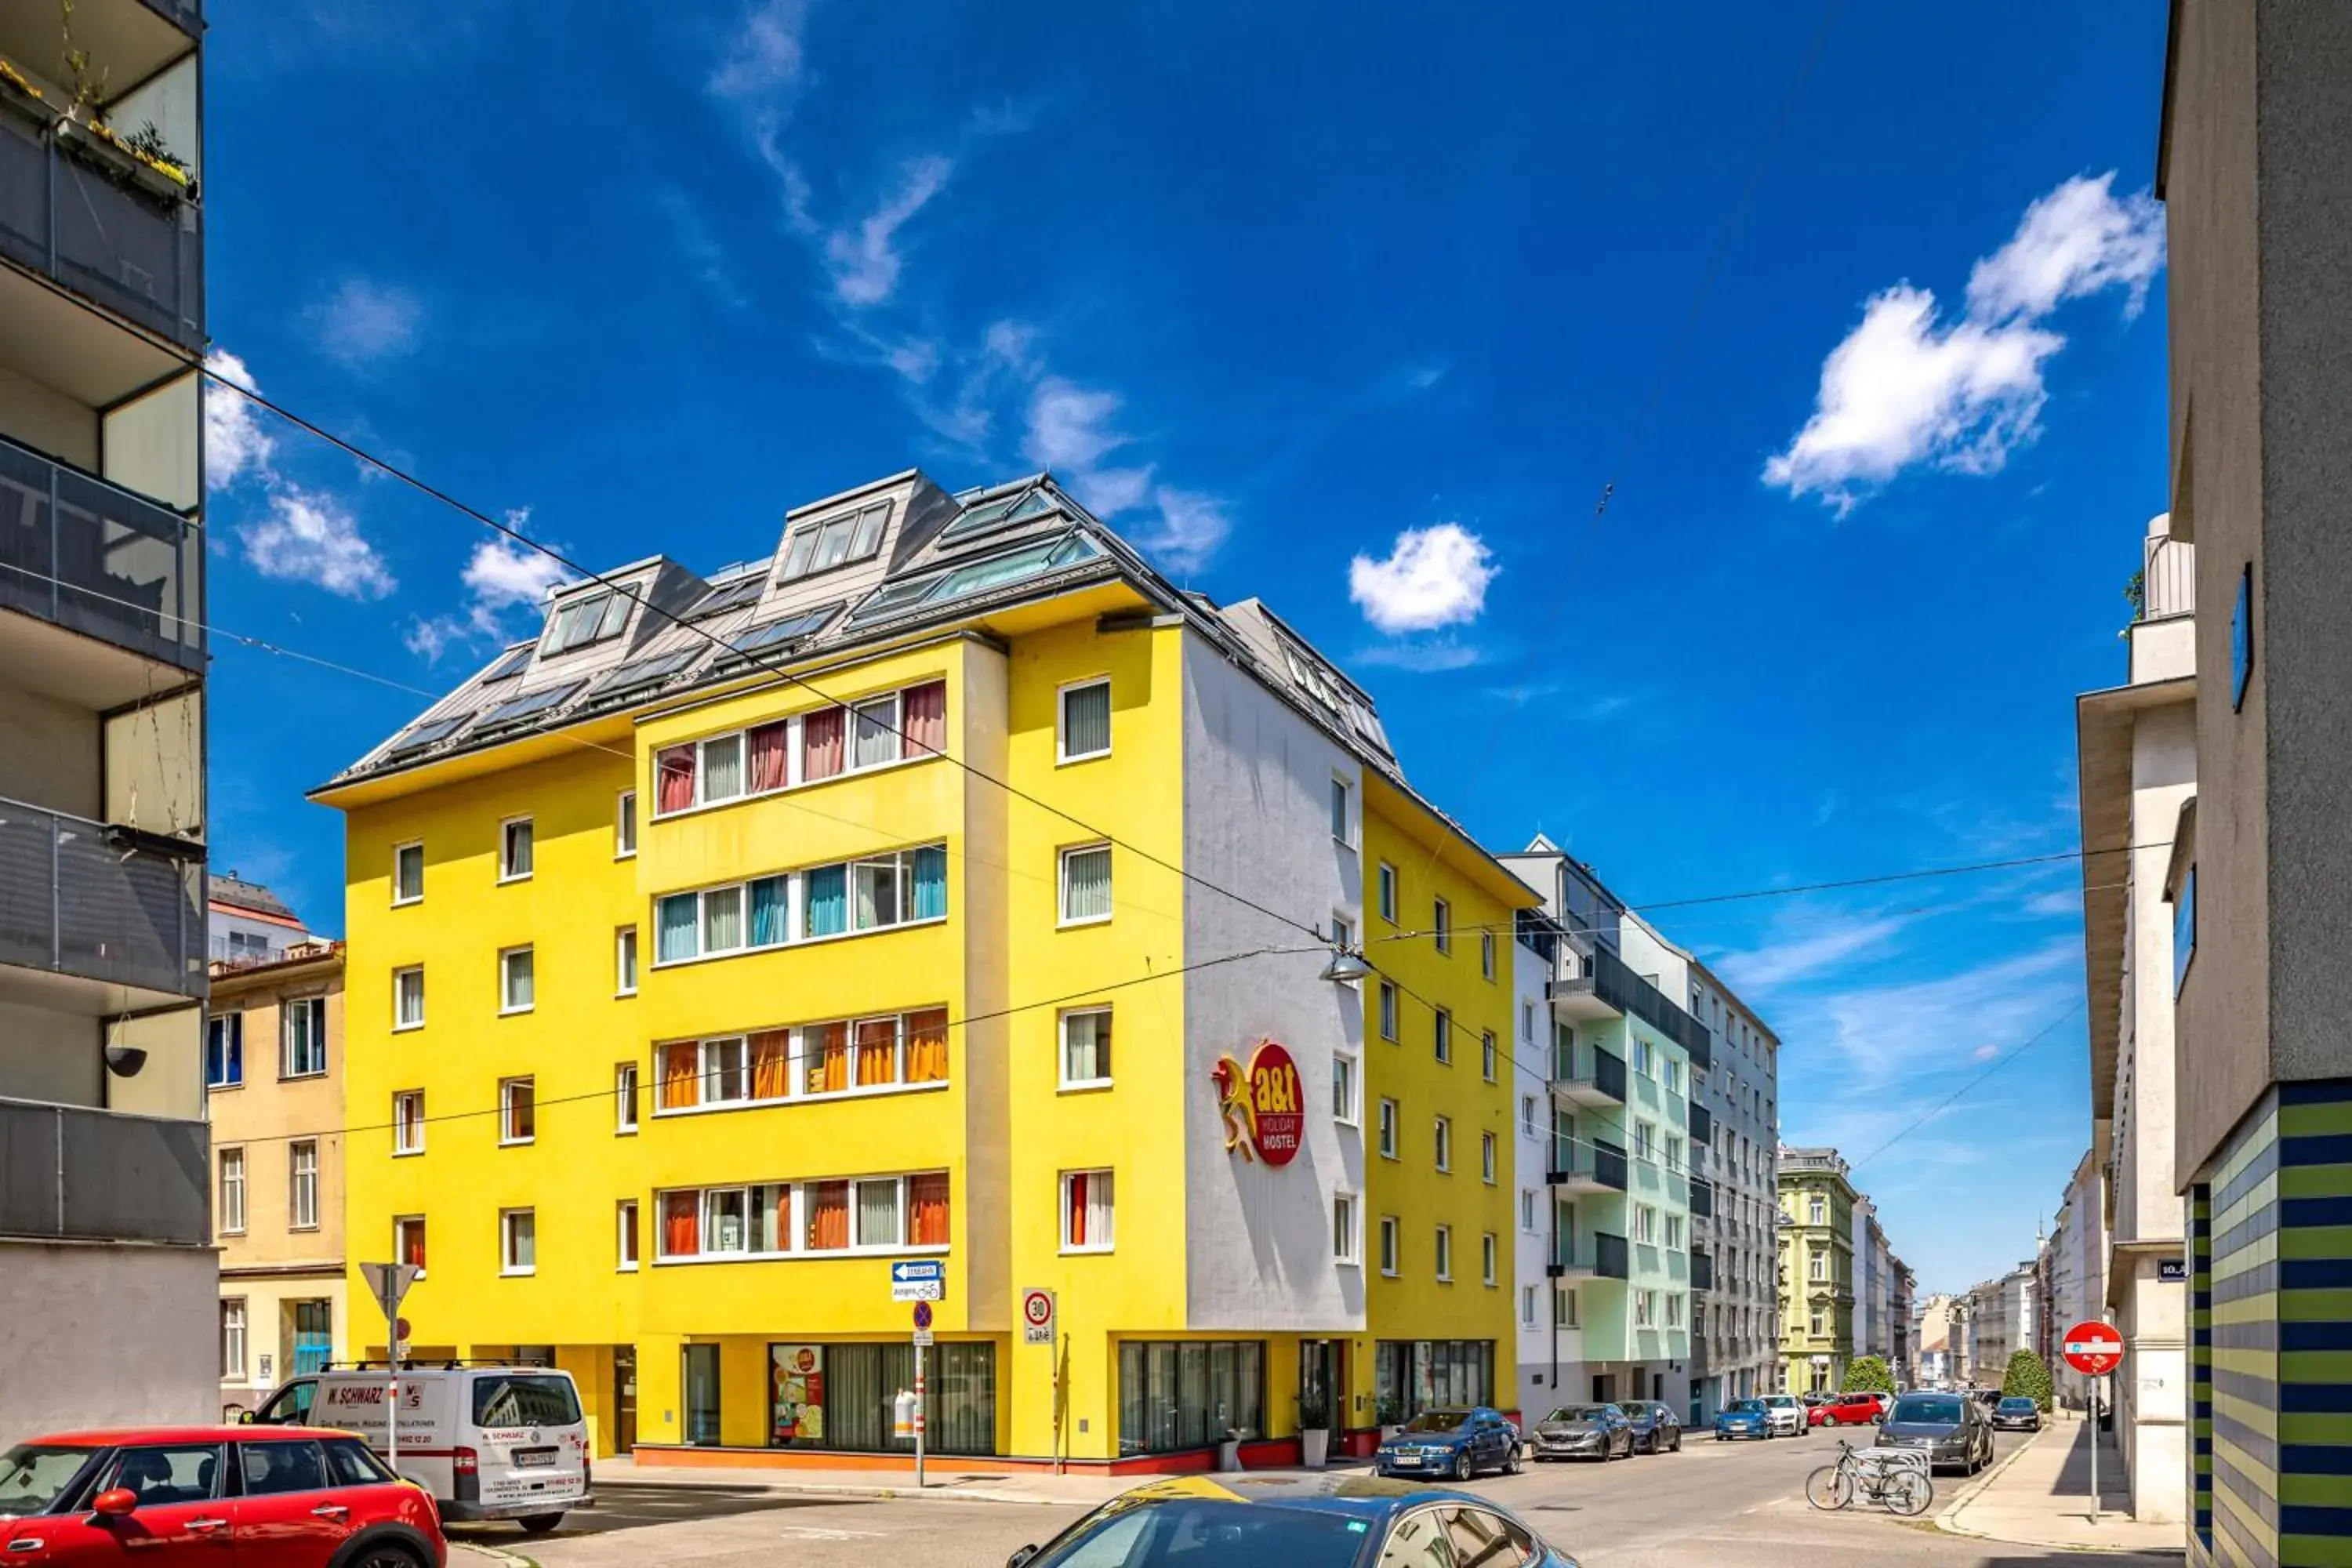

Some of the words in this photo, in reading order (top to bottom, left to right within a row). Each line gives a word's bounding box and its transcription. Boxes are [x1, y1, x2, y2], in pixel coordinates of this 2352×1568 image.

[1261, 1116, 1295, 1131] HOLIDAY
[1263, 1134, 1297, 1149] HOSTEL
[1031, 1301, 1045, 1316] 30
[340, 1387, 383, 1405] SCHWARZ
[415, 1435, 422, 1443] 12
[423, 1435, 432, 1443] 20
[492, 1432, 525, 1440] SCHWARZ
